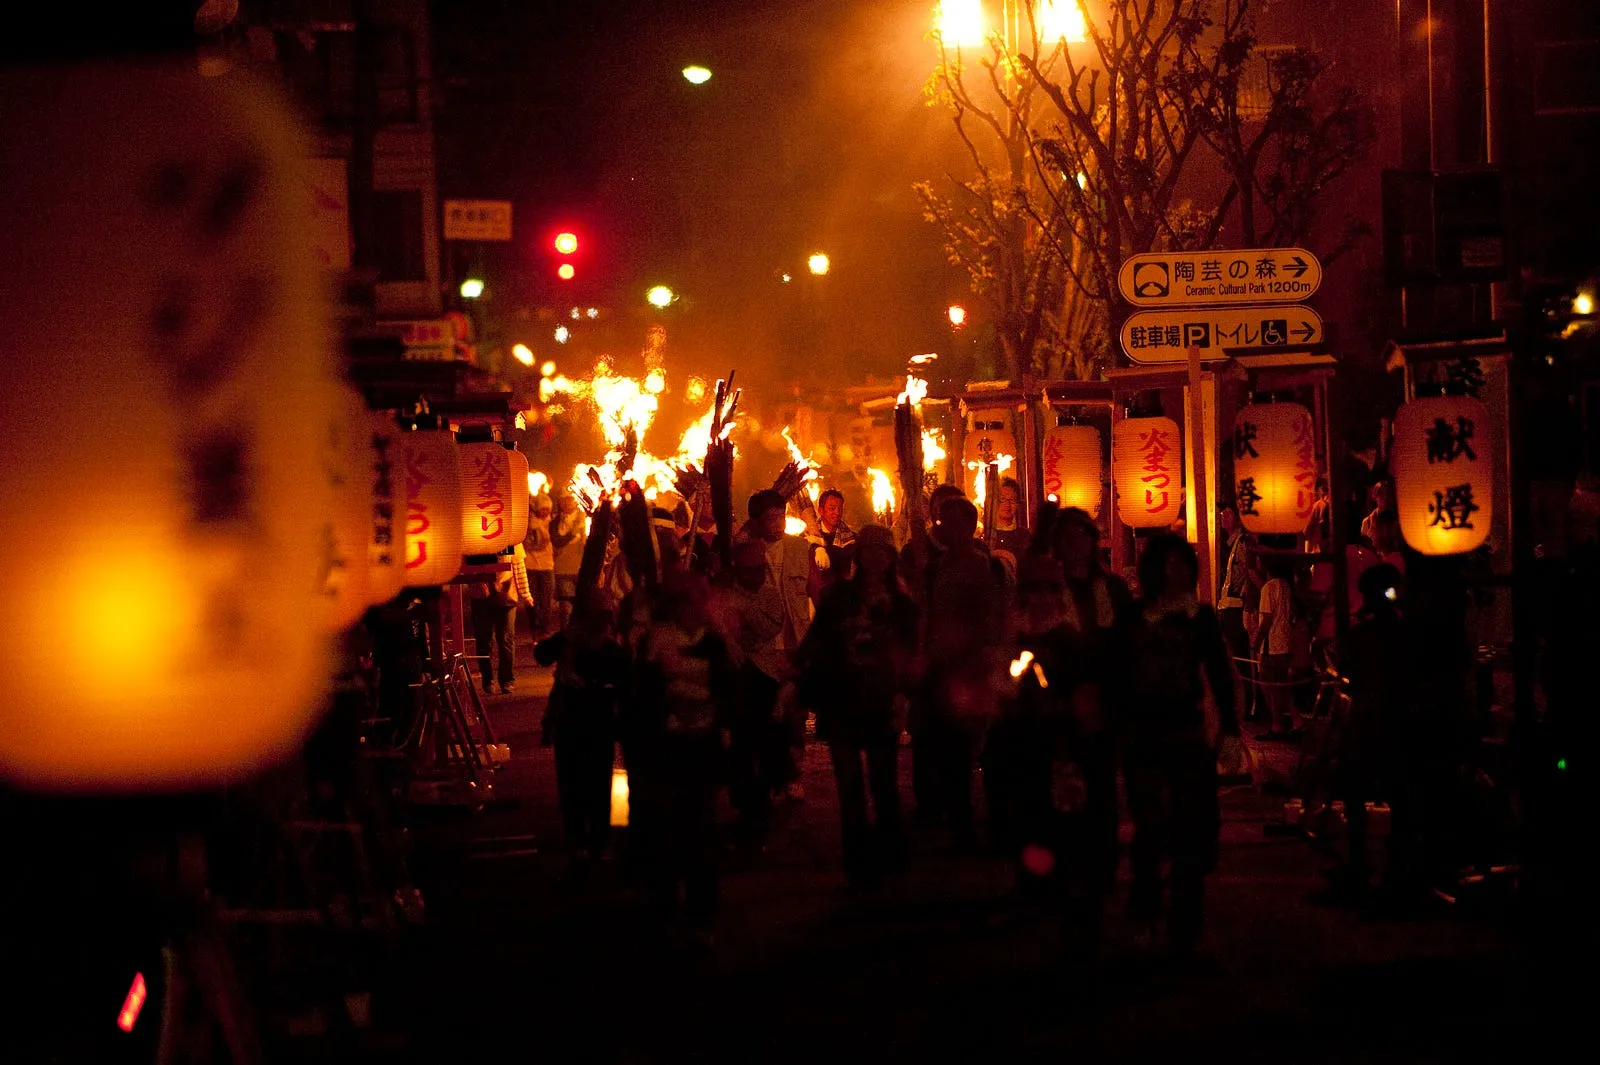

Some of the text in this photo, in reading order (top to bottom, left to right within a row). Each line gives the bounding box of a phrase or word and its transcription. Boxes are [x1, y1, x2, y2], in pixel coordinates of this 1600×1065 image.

[1174, 258, 1277, 283] 陶芸の森
[1185, 280, 1311, 297] Ceramic Cultural Park 1200m
[1130, 325, 1181, 349] 駐車場
[1215, 323, 1259, 345] トイレ
[474, 452, 506, 540] 火まつり
[1139, 428, 1171, 514] 火まつり
[1426, 416, 1480, 530] 献燈
